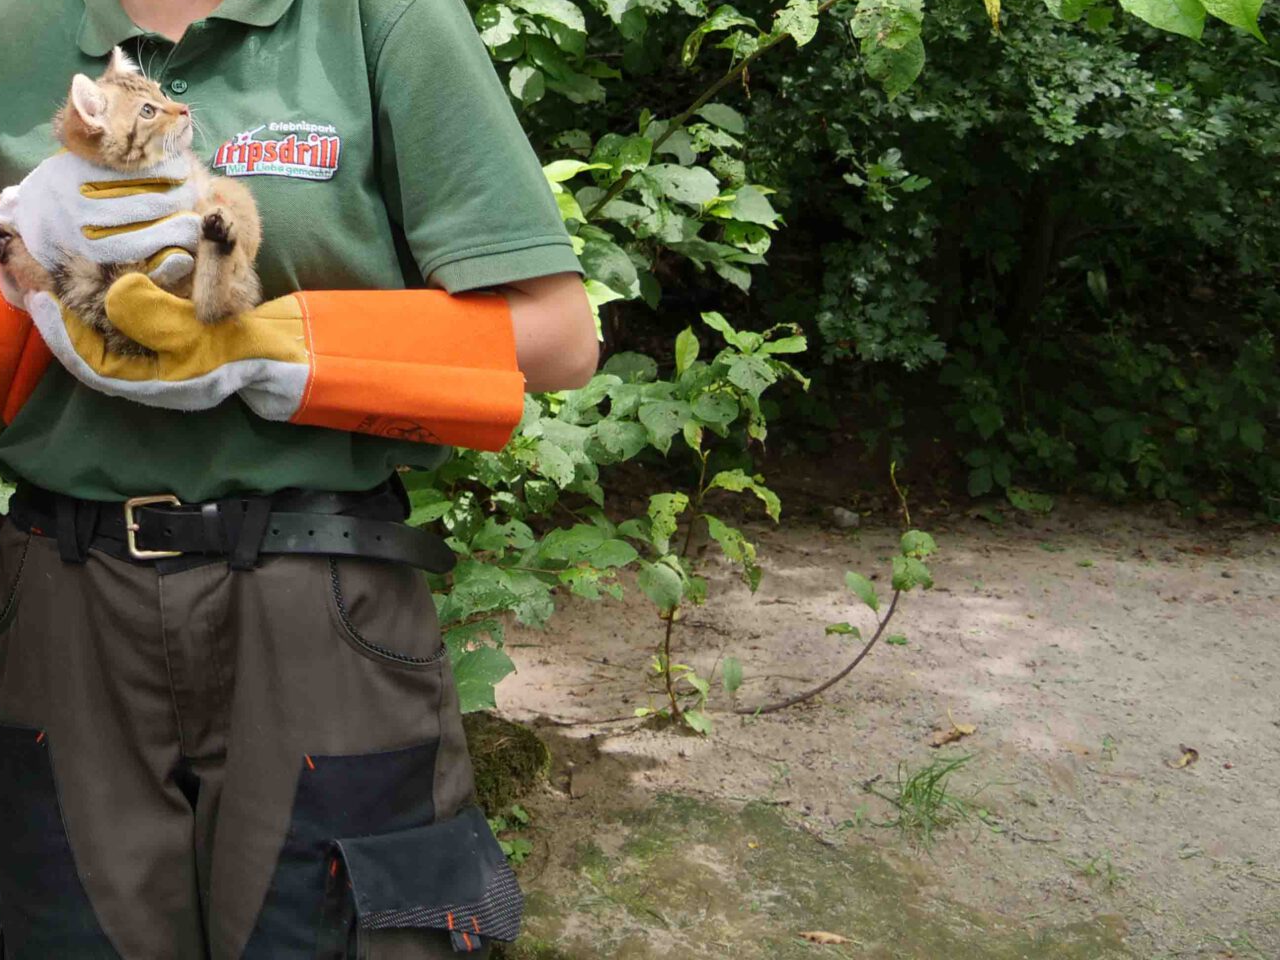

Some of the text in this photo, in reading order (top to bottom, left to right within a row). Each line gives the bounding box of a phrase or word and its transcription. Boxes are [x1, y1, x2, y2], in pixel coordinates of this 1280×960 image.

[268, 120, 337, 134] Erlebnispark
[215, 134, 340, 171] Tripsdrill
[228, 164, 246, 175] Mit
